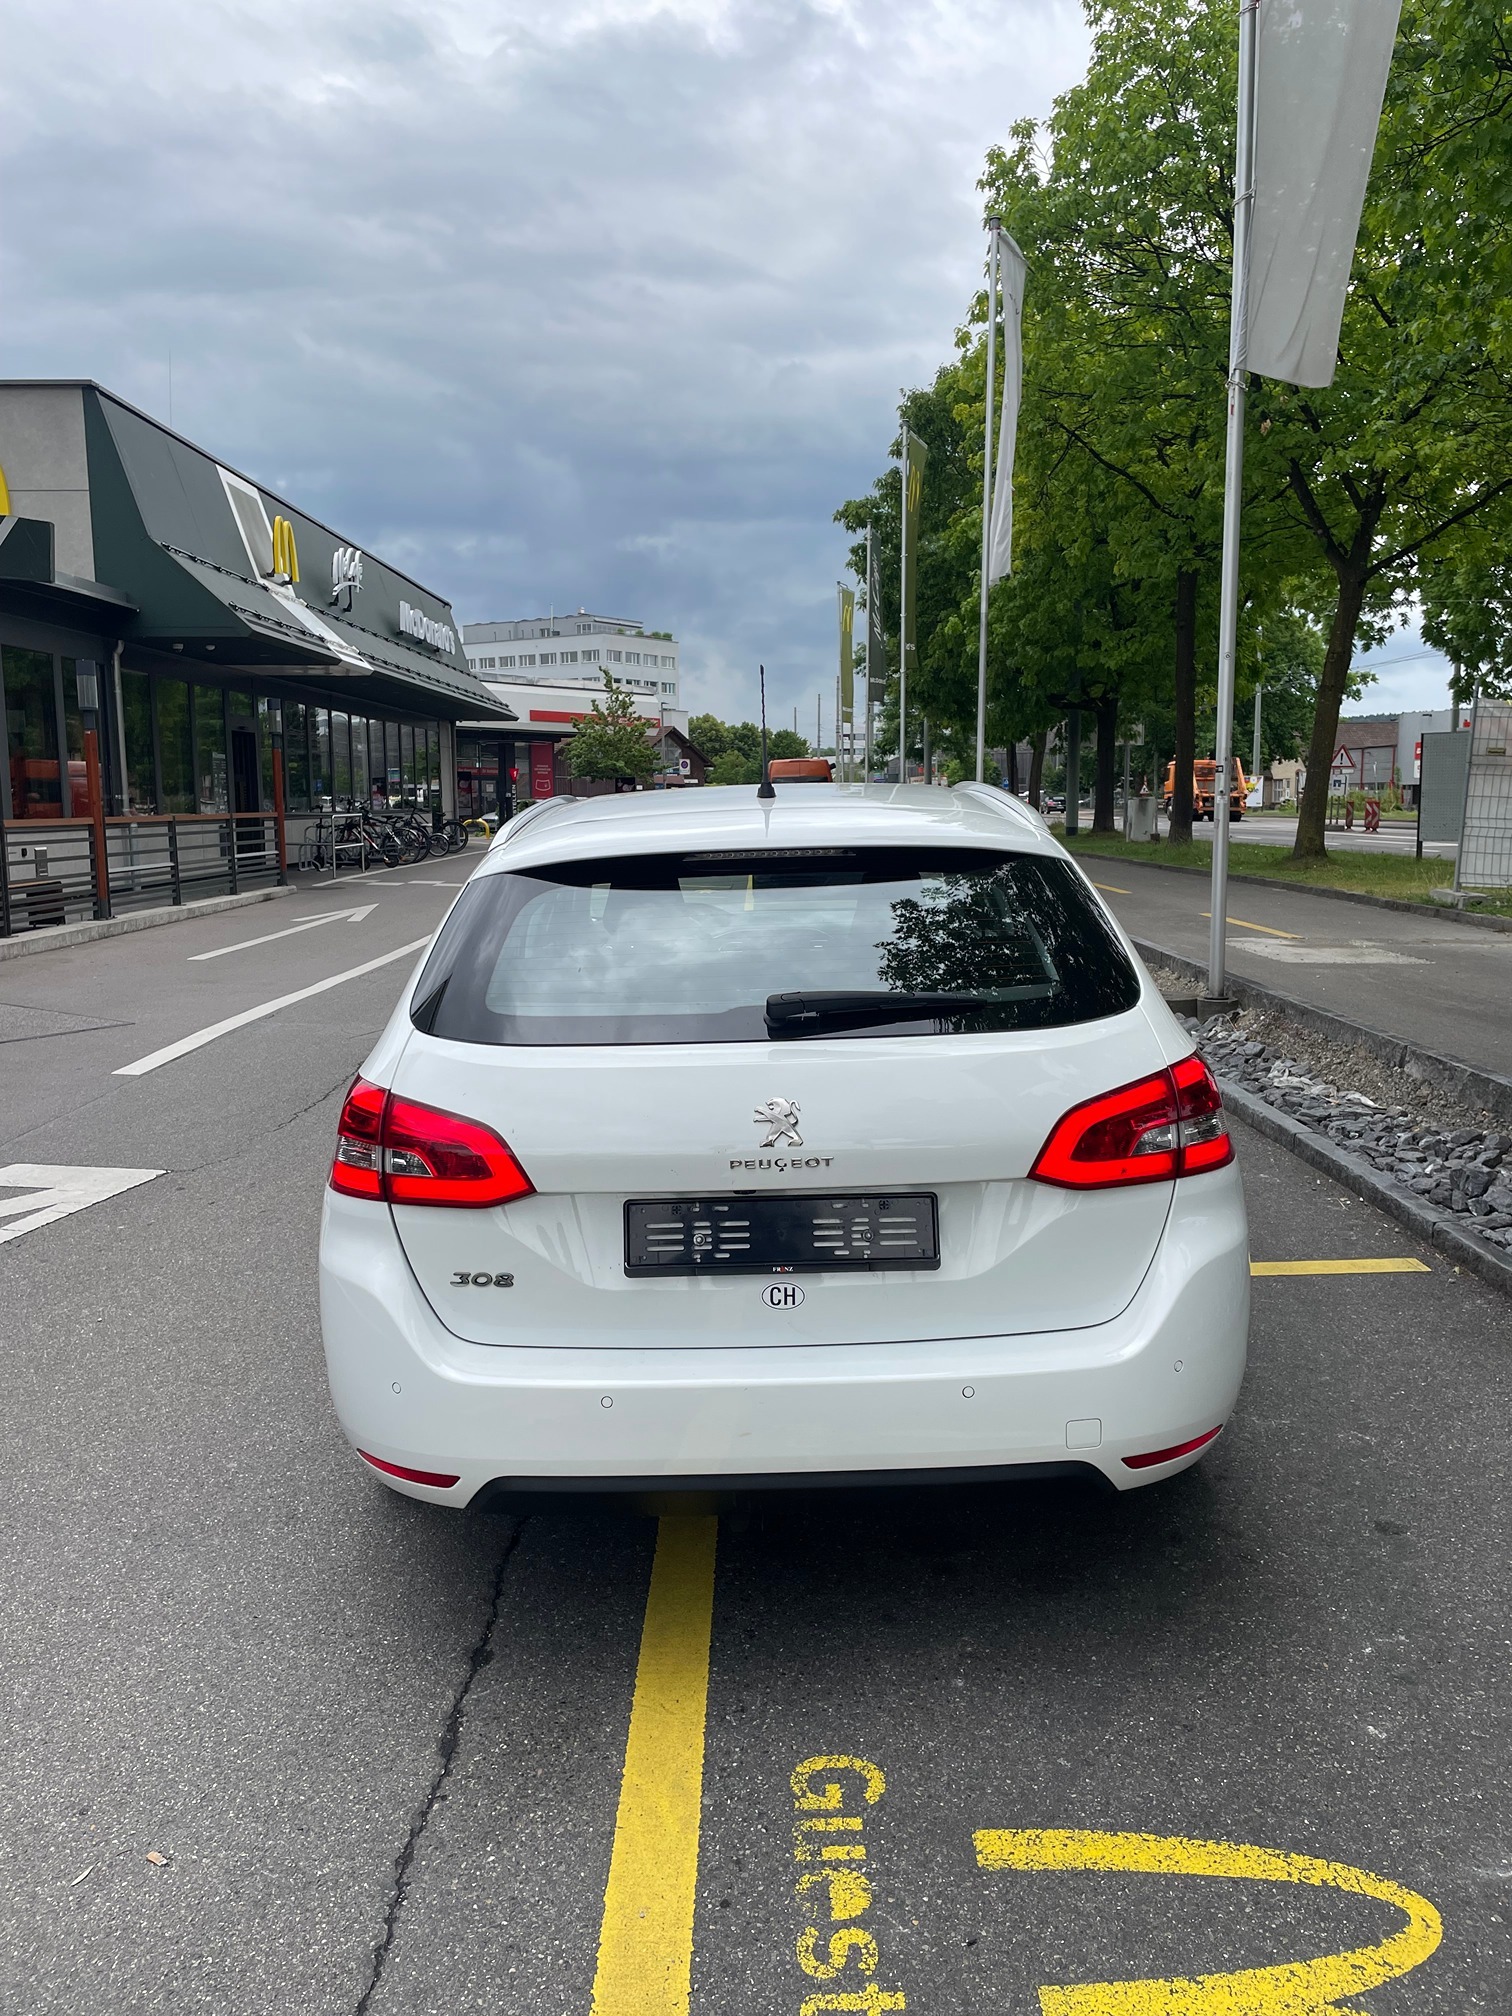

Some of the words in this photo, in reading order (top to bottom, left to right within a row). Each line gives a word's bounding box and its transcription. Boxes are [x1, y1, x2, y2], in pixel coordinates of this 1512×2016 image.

[399, 600, 456, 656] McDonald's
[729, 1156, 834, 1172] PEUGEOT
[449, 1271, 515, 1288] 308
[769, 1286, 796, 1306] CH
[790, 1755, 907, 2016] Guest
